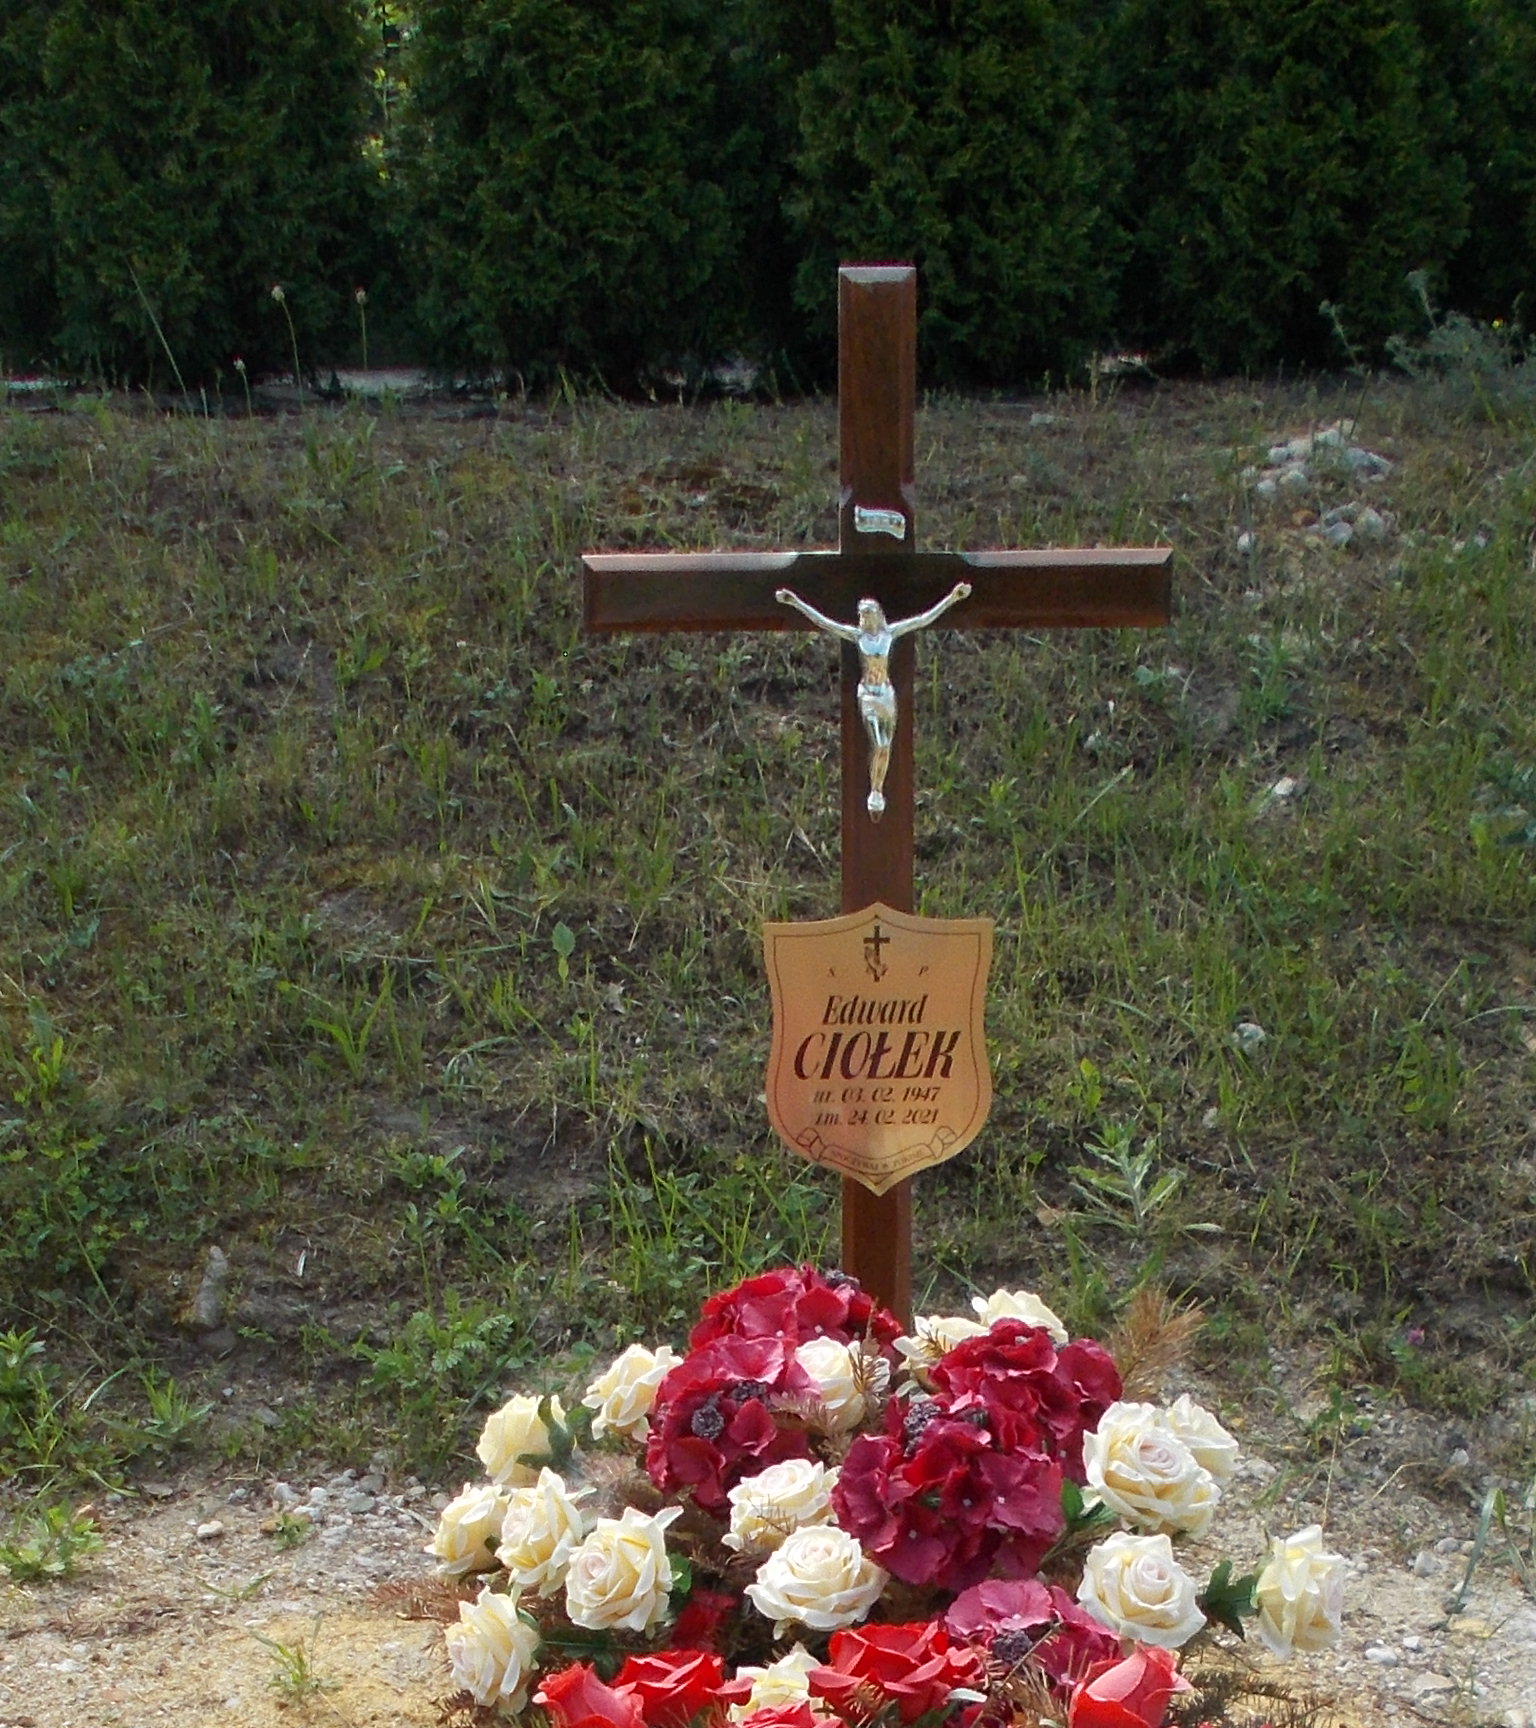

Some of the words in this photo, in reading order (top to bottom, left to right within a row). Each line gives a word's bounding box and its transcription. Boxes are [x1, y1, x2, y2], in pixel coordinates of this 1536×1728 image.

[822, 994, 928, 1026] Edward
[793, 1030, 962, 1081] CIOŁEK
[902, 1086, 942, 1102] 1947
[901, 1109, 939, 1125] 2021
